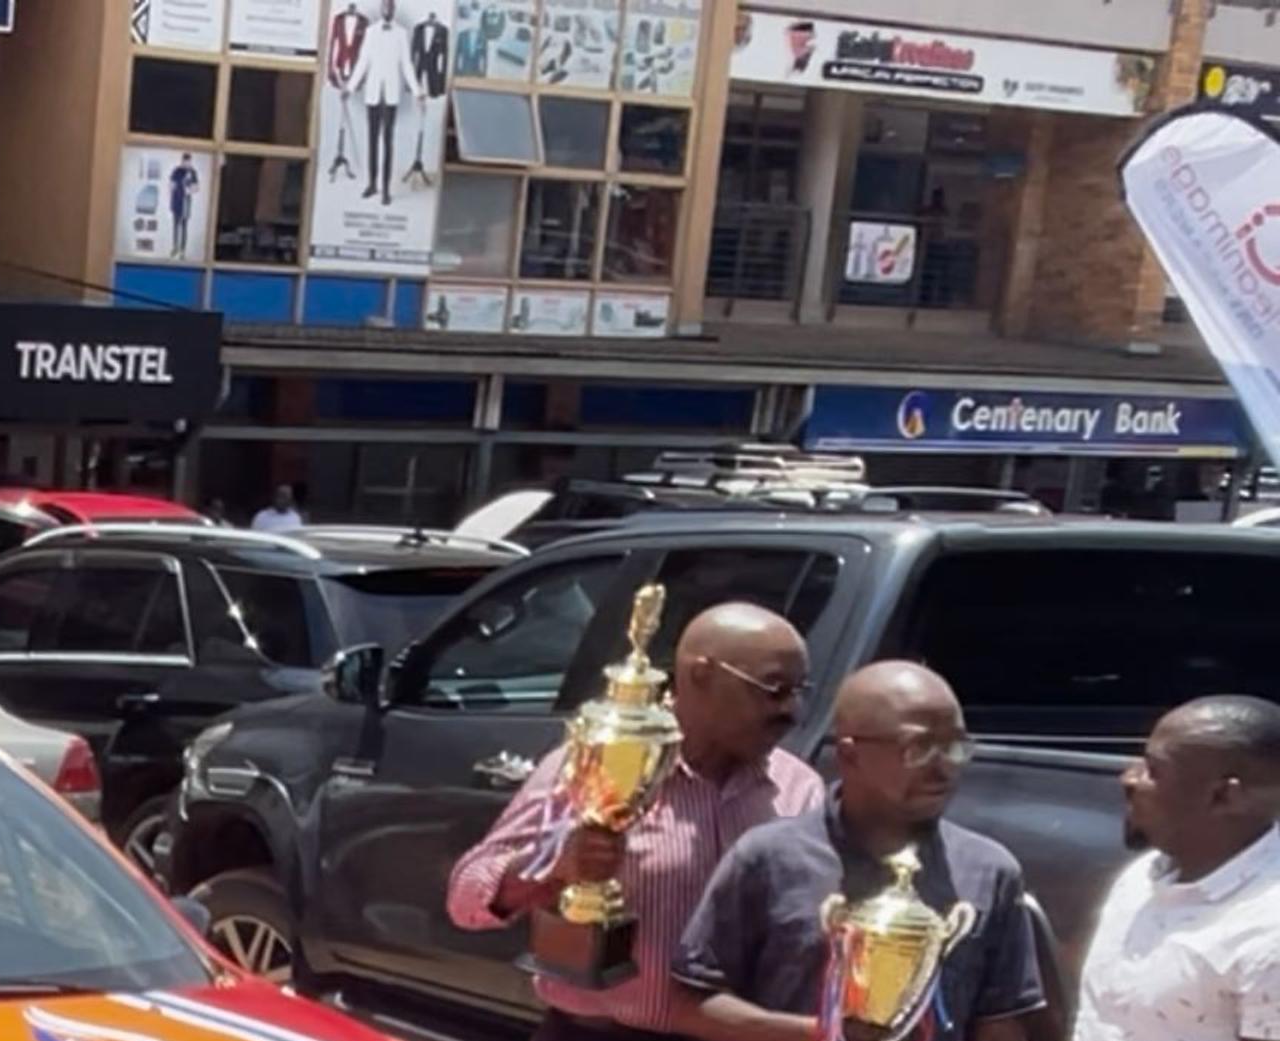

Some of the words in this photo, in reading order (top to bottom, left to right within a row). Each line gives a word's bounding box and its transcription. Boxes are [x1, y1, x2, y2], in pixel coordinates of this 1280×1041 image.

[15, 341, 173, 384] TRANSTEL
[951, 397, 1101, 440] Centenary
[1114, 402, 1181, 436] Bank
